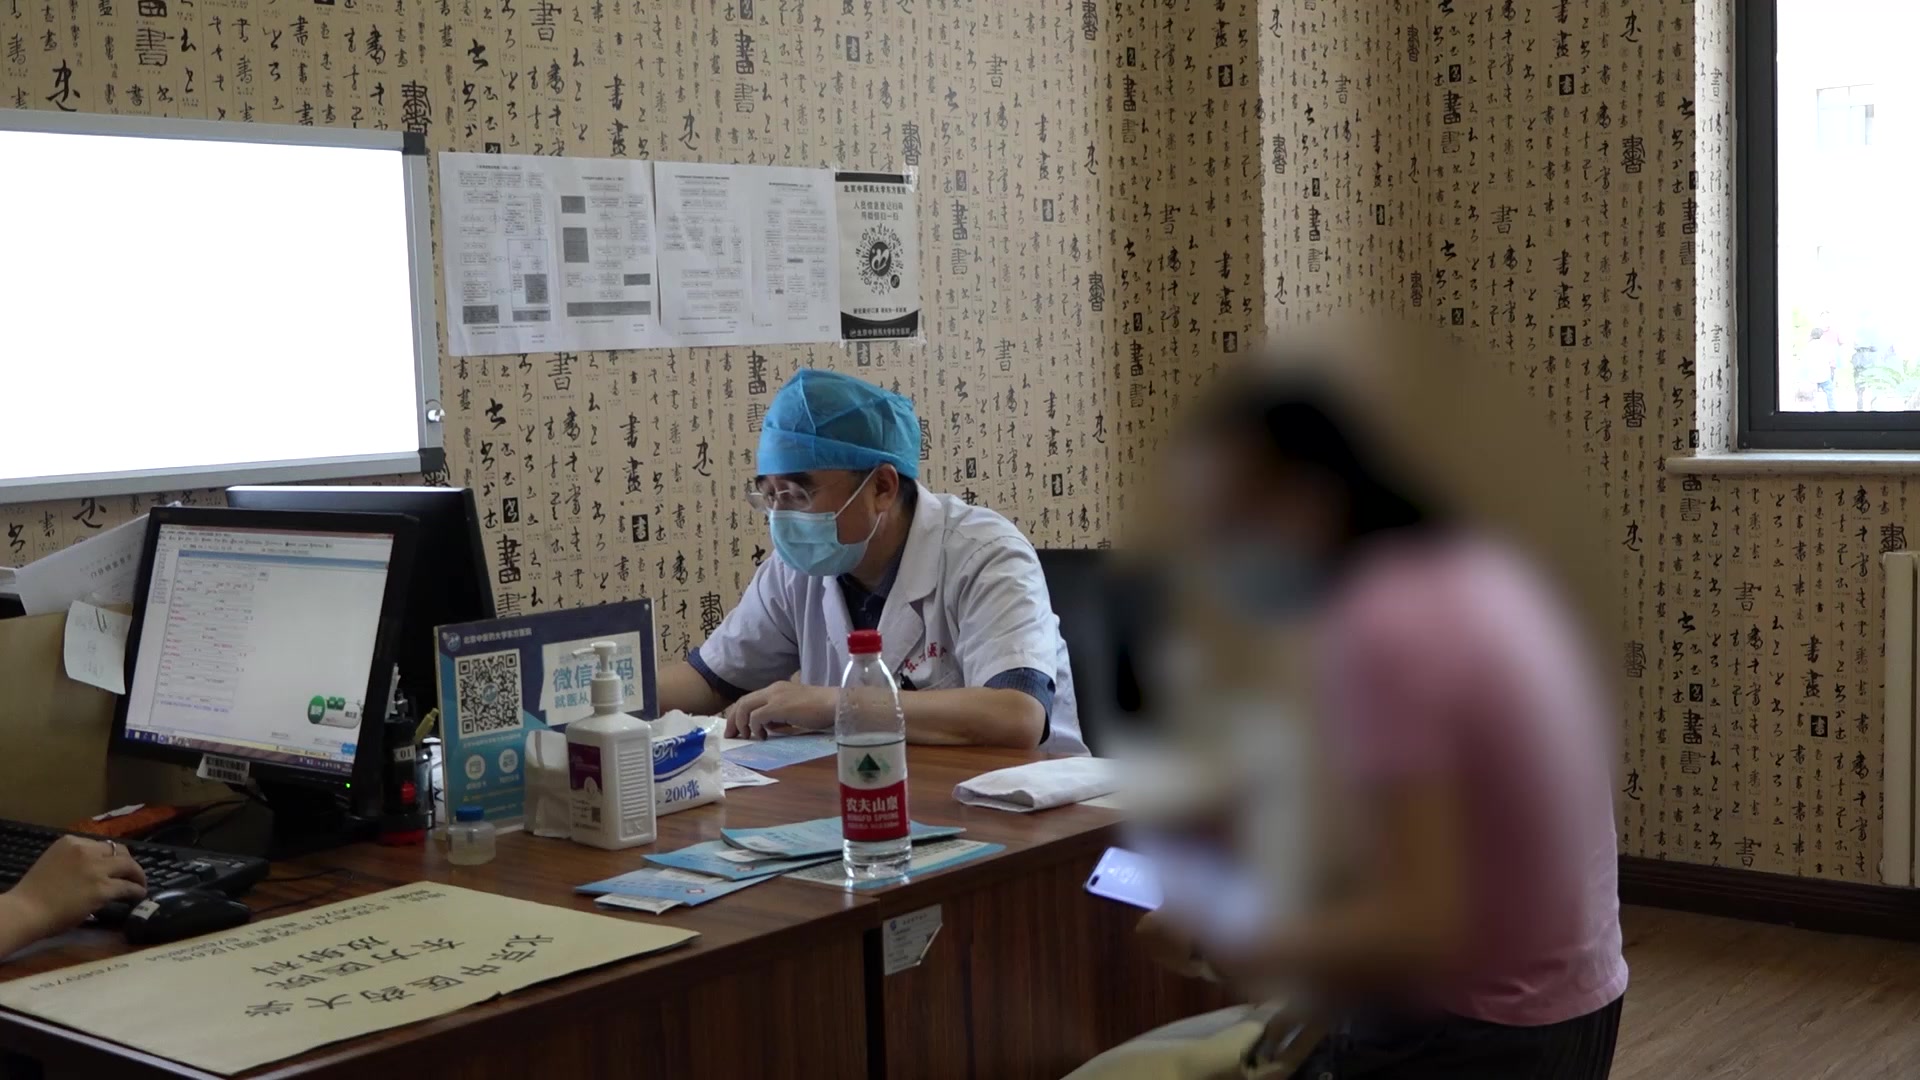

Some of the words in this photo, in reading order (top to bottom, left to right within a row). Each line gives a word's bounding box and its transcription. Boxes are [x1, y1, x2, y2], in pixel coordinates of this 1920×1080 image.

[554, 684, 636, 709] 就医从松
[665, 780, 700, 803] 200张
[846, 796, 898, 812] 农夫山泉
[252, 936, 389, 976] 放射科
[266, 938, 465, 990] 东方医院
[245, 935, 553, 1016] 北京中医药大学
